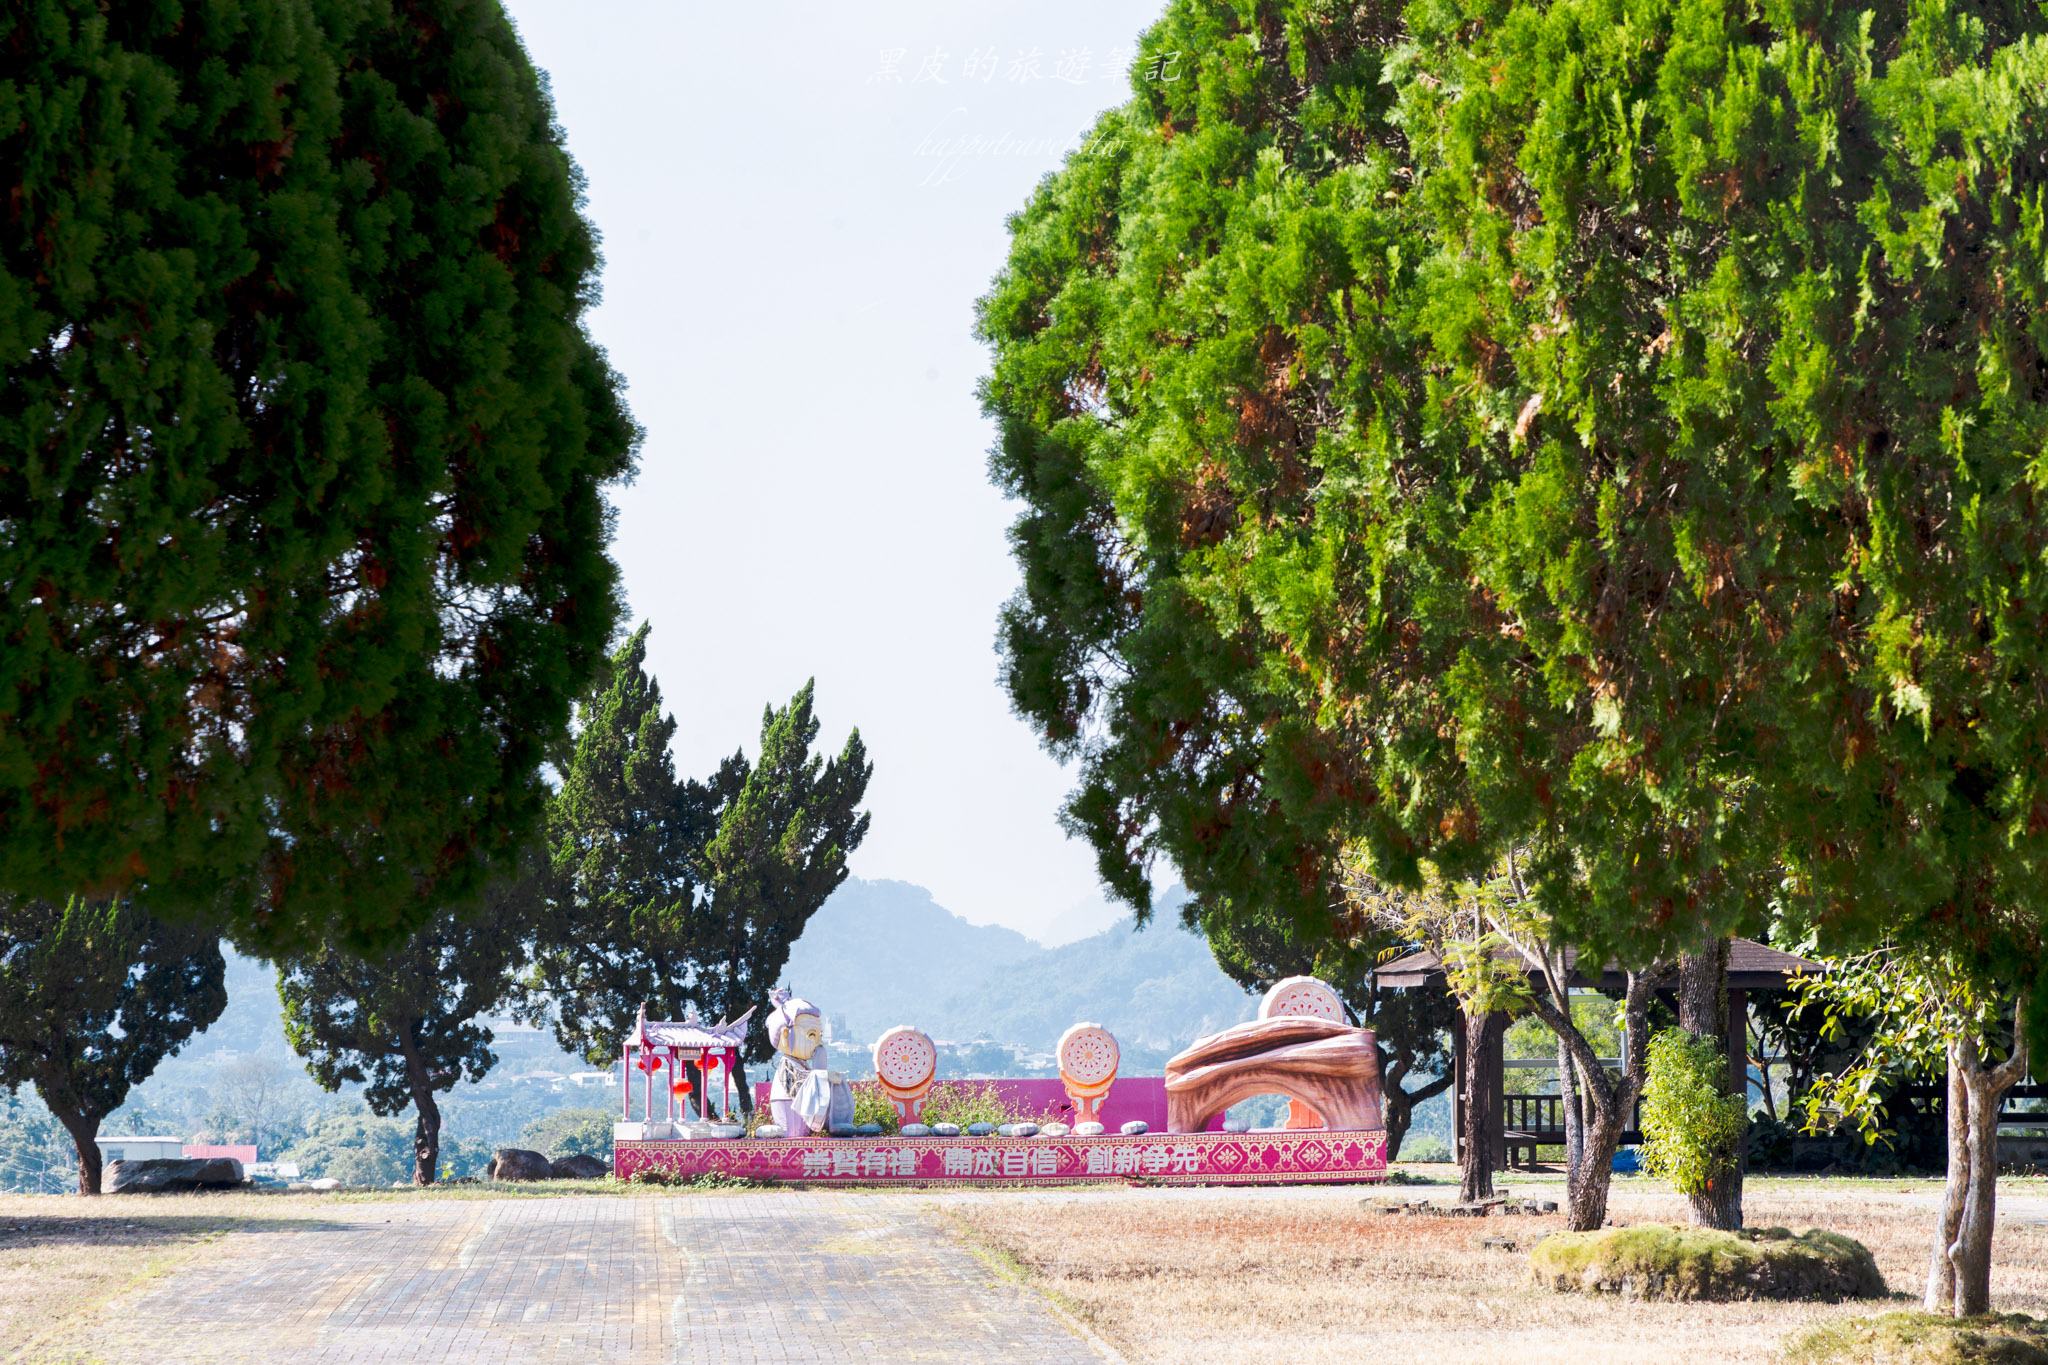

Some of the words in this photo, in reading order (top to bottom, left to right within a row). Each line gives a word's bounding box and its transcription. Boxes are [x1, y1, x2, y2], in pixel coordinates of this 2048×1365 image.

[802, 1148, 917, 1176] 崇賢有禮
[945, 1147, 1058, 1175] 開放自信
